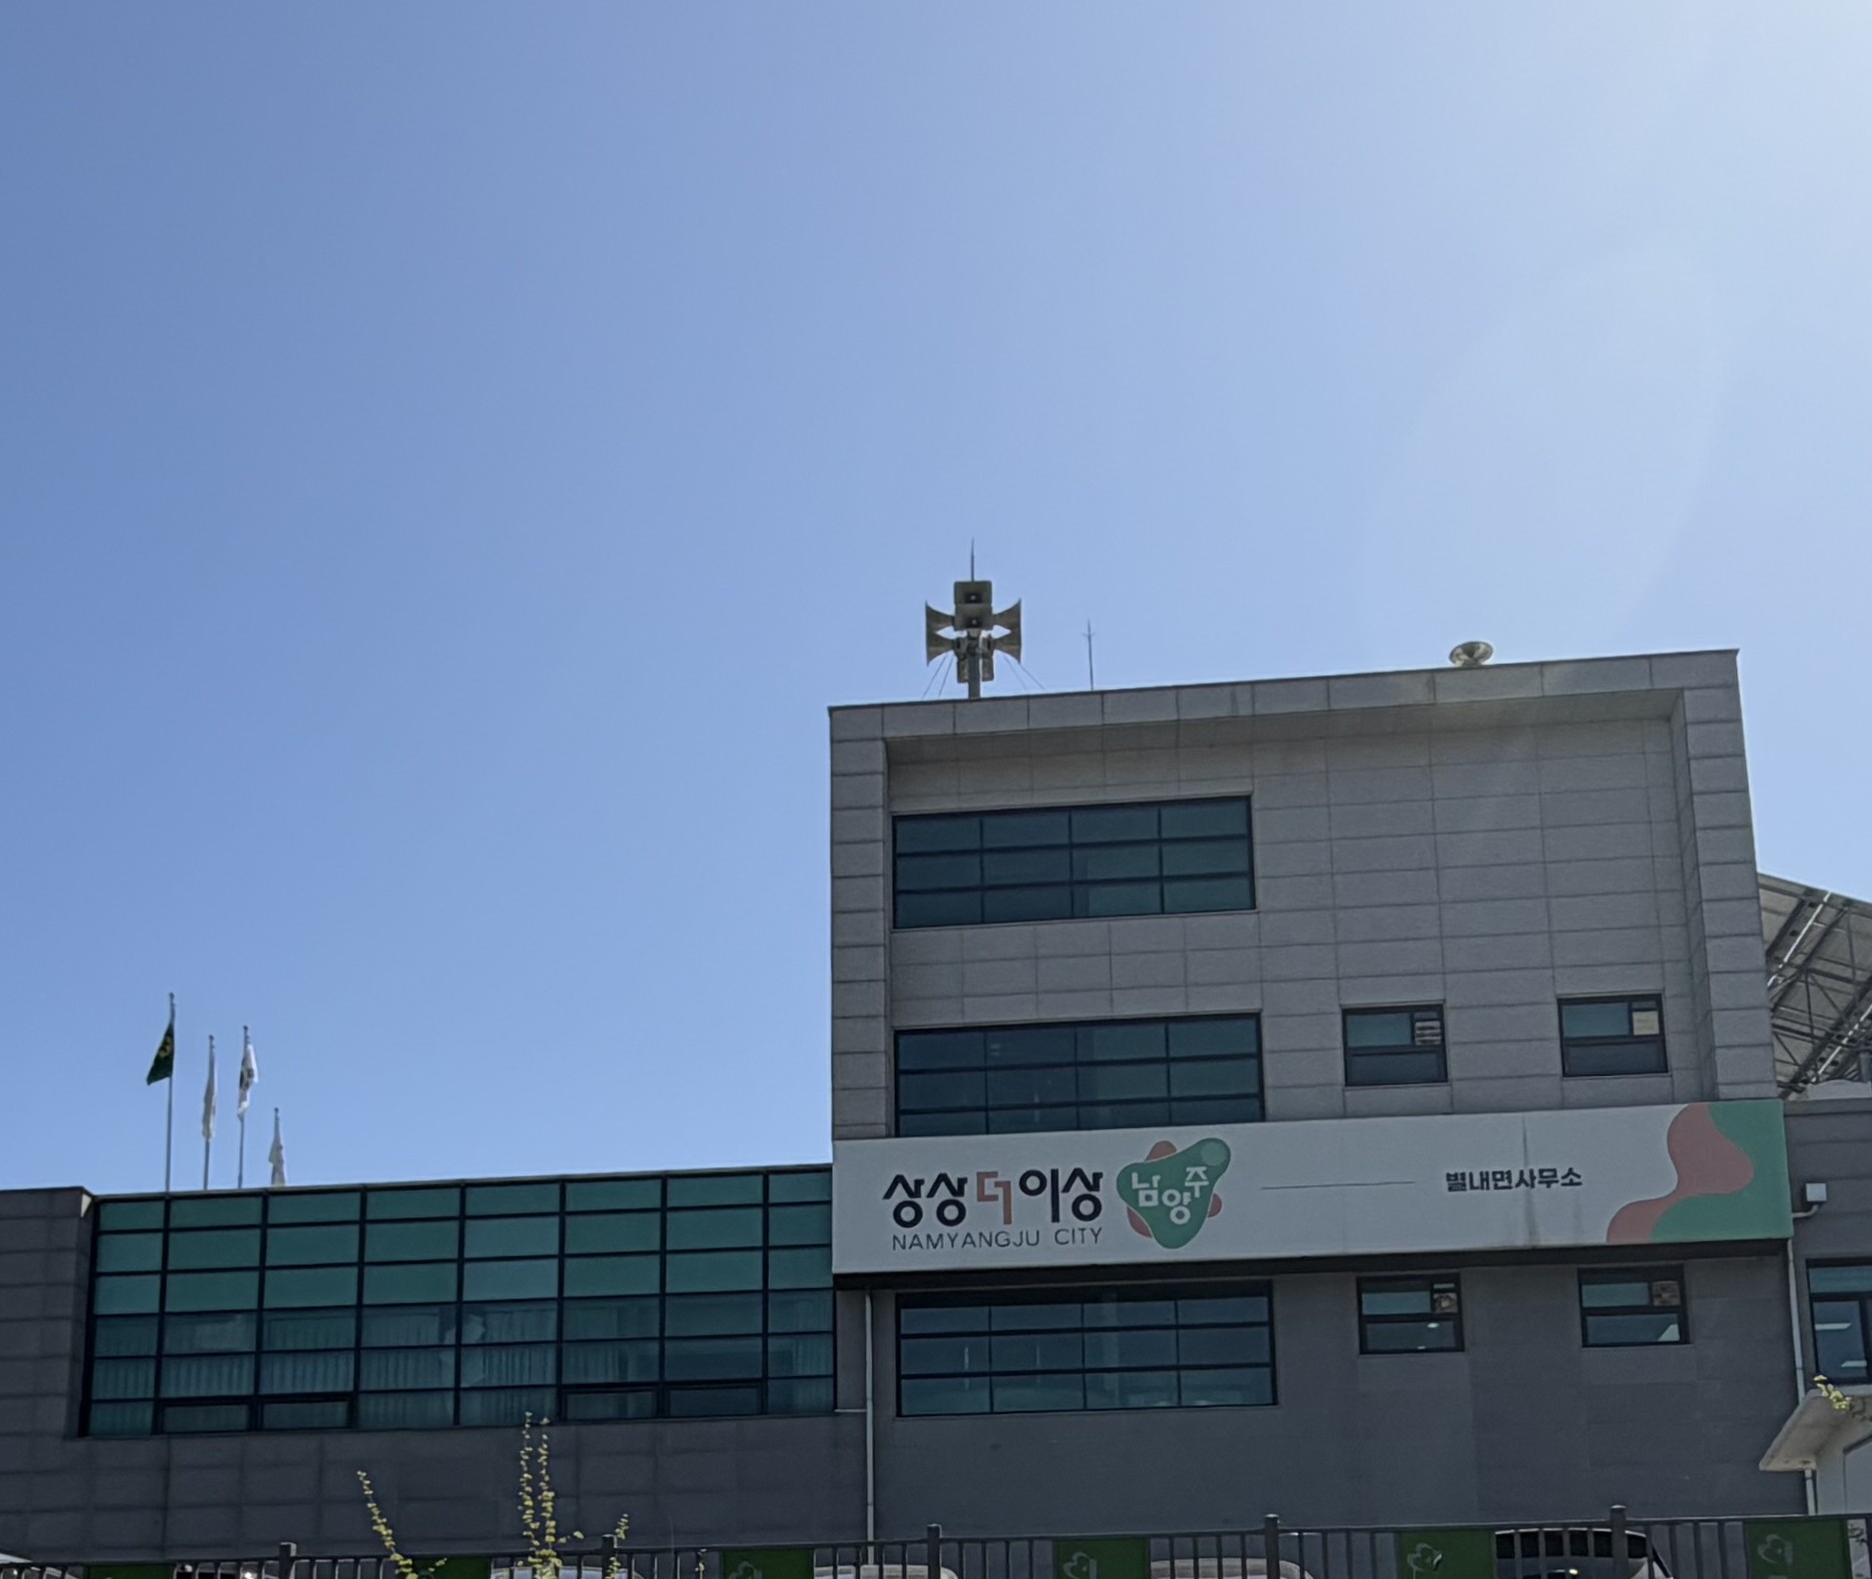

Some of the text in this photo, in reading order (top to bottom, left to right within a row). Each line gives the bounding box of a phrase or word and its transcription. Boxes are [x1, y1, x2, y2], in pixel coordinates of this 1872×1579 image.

[1446, 1168, 1583, 1192] 별내면사무소
[1132, 1165, 1210, 1225] 남양주
[893, 1227, 1103, 1251] NAMYANGJU CITY
